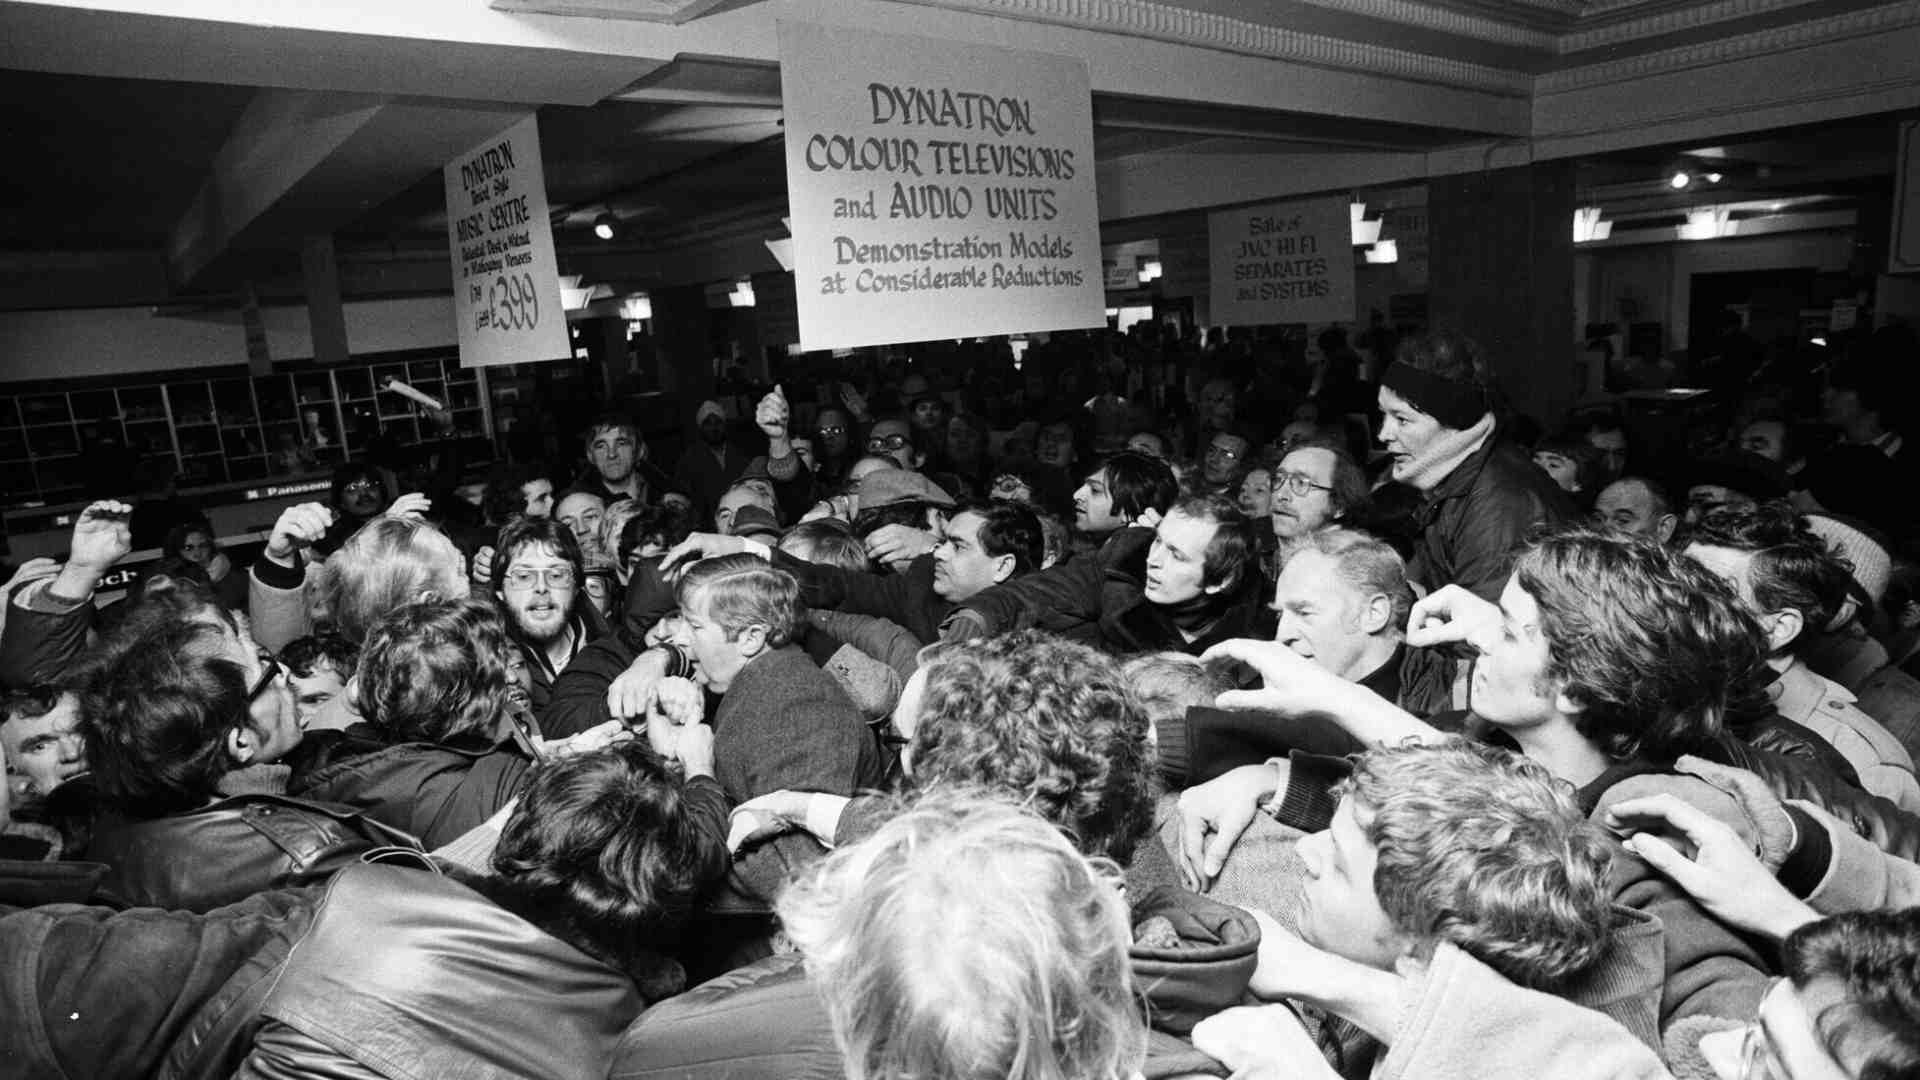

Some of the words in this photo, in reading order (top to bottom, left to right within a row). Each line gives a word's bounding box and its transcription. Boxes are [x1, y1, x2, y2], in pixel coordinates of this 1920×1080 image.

[868, 83, 1035, 136] DYNATRON
[461, 140, 515, 191] DYNATRON
[805, 134, 923, 177] COLOUR
[928, 139, 1075, 180] TELEVISIONS
[457, 212, 484, 242] MUSIC
[489, 194, 530, 232] CENTRE
[833, 190, 877, 220] and
[889, 182, 973, 219] AUDIO
[984, 186, 1058, 221] UNITS
[833, 234, 1002, 265] Demonstration
[1009, 232, 1073, 260] Models
[1233, 239, 1272, 259] JVC
[1277, 237, 1296, 256] HI
[1300, 235, 1317, 254] FI
[820, 272, 846, 294] at
[856, 264, 987, 294] Considerable
[991, 262, 1084, 290] Reductions
[1234, 258, 1328, 280] SEPARATES
[489, 273, 539, 331] £399
[1259, 279, 1330, 301] SYSTEMS
